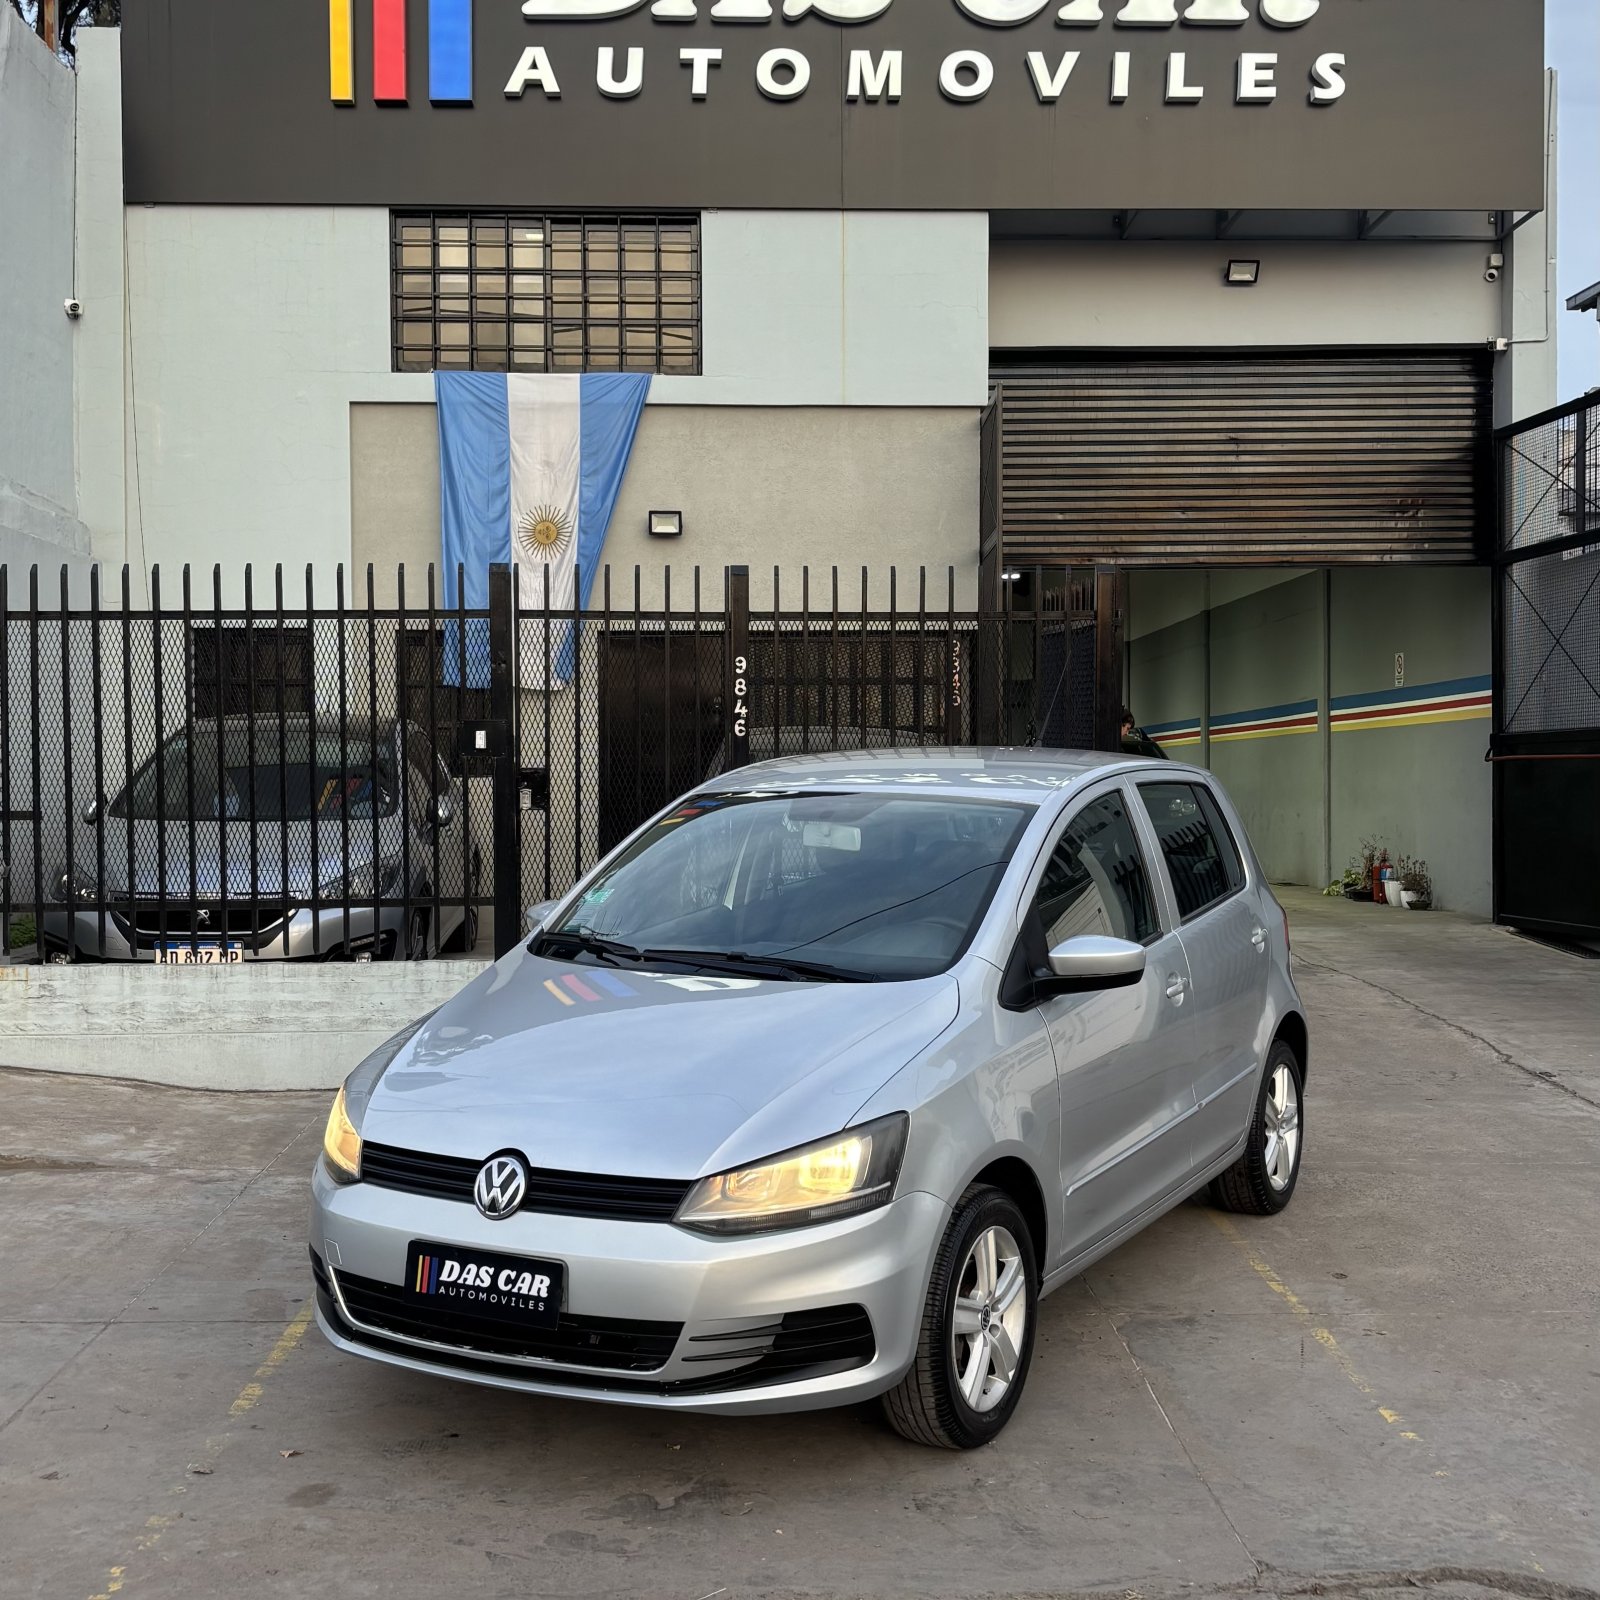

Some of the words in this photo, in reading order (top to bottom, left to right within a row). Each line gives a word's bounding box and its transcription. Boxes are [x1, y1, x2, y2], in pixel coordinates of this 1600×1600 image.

[503, 46, 1346, 102] AUTOMOVILES
[734, 656, 748, 737] 9846
[438, 1286, 546, 1312] AUTOMOVILES
[439, 1260, 495, 1288] DAS
[497, 1269, 551, 1298] CAR
